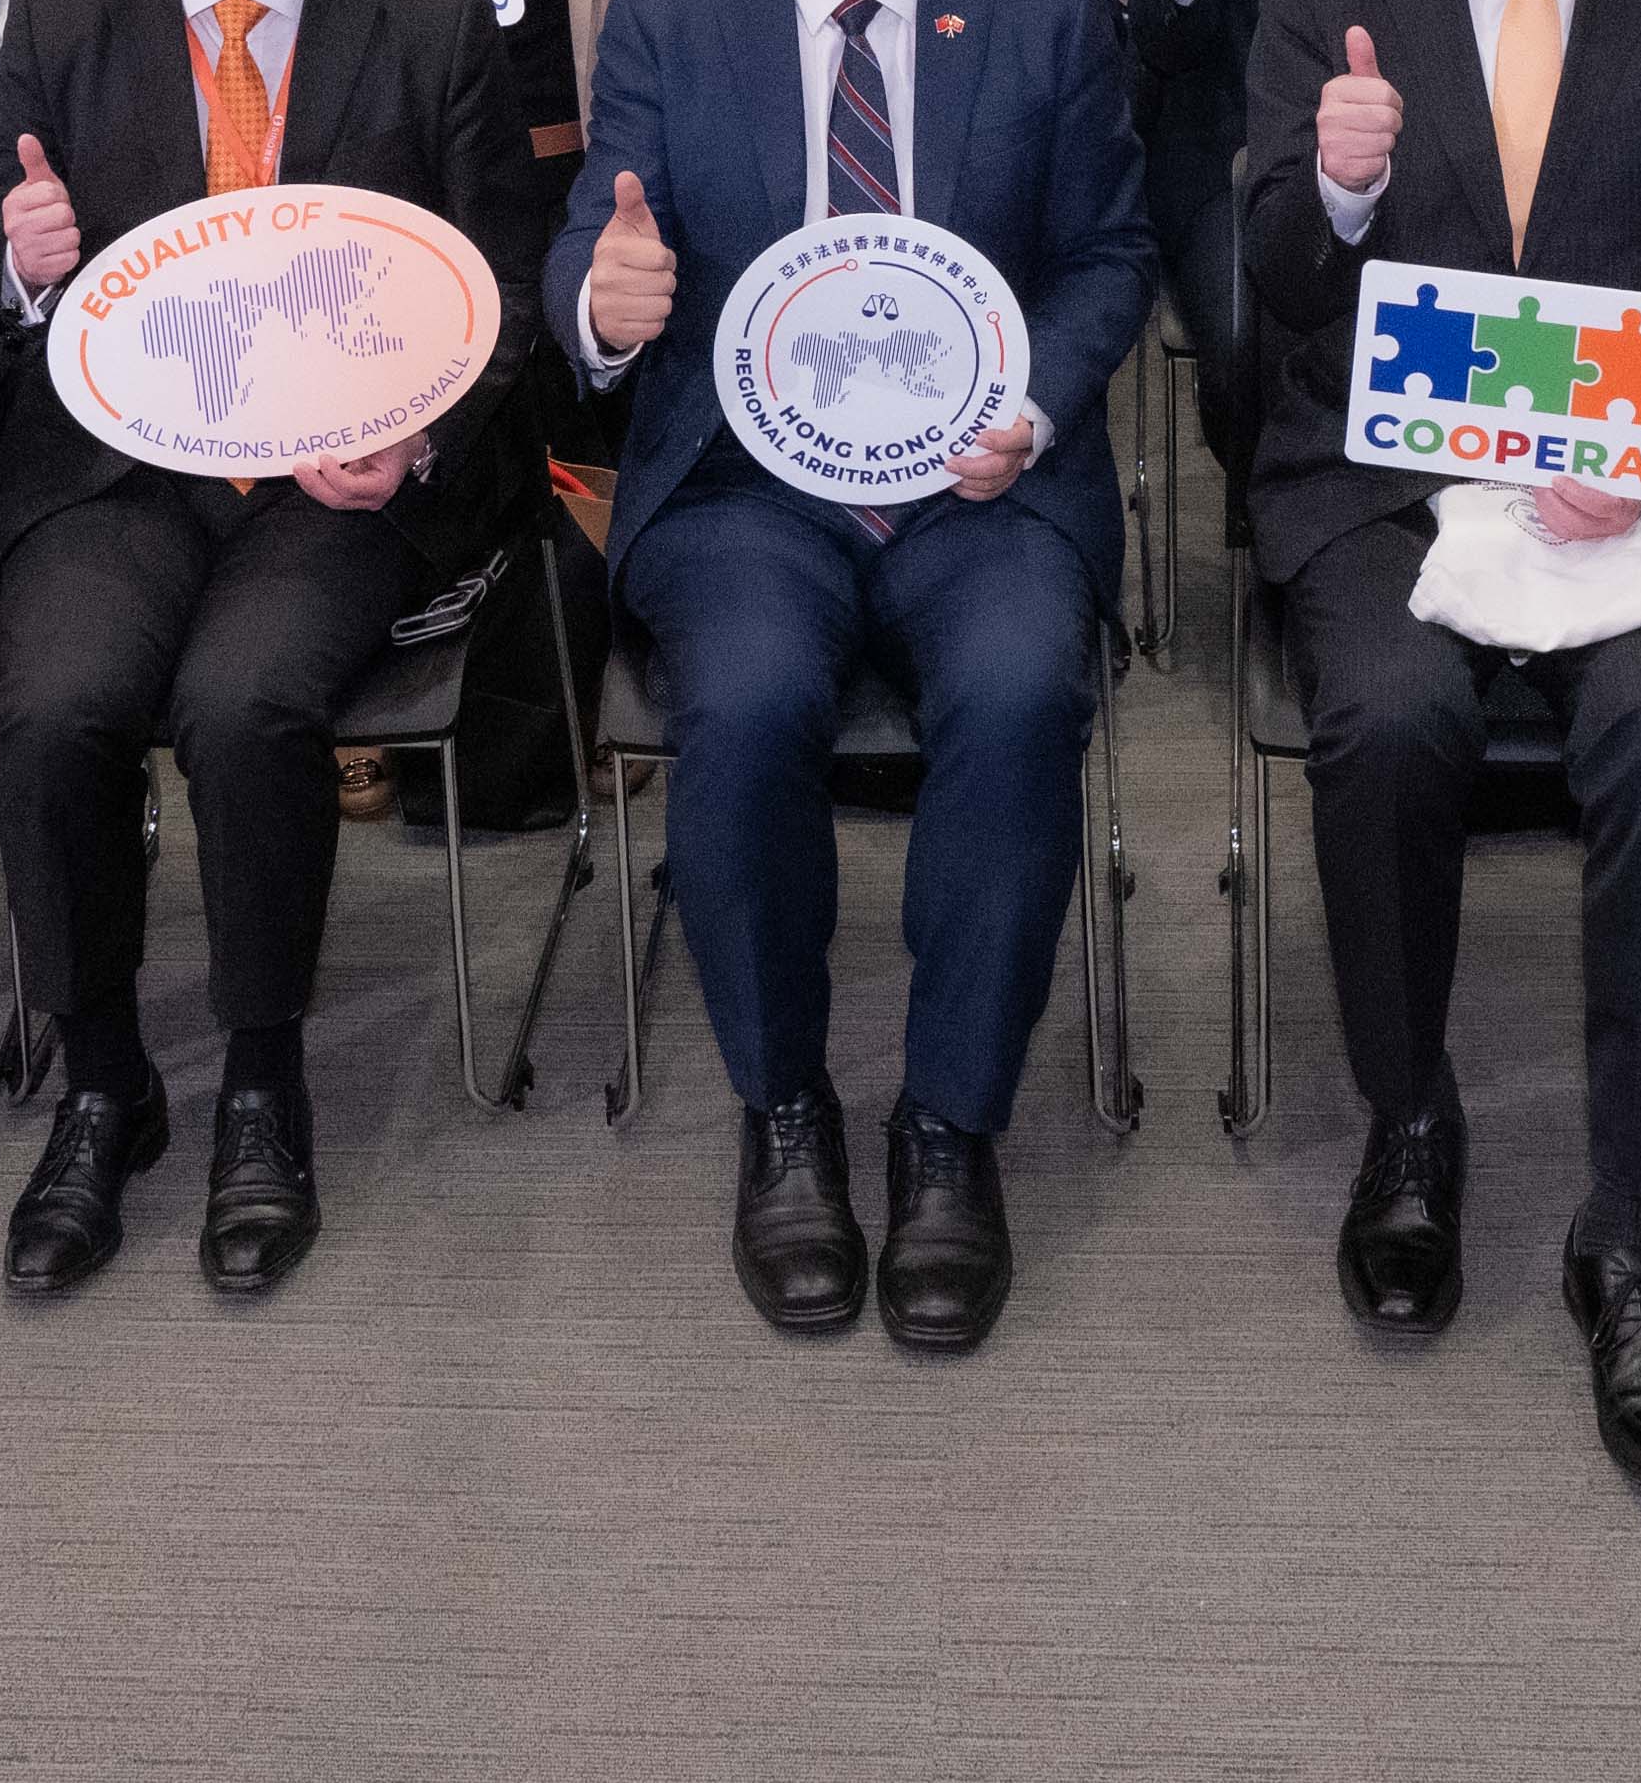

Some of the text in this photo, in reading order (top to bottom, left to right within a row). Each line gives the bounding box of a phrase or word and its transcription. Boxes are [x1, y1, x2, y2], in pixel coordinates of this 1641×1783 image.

[82, 201, 324, 321] EQUALITY OF
[779, 235, 988, 305] 亞非法協香港區域仲裁中心
[127, 356, 470, 459] ALL NATIONS LARGE AND SMALL
[736, 348, 1006, 485] REGIONAL ARBITRATION CENTRE
[779, 405, 945, 461] HONG KONG
